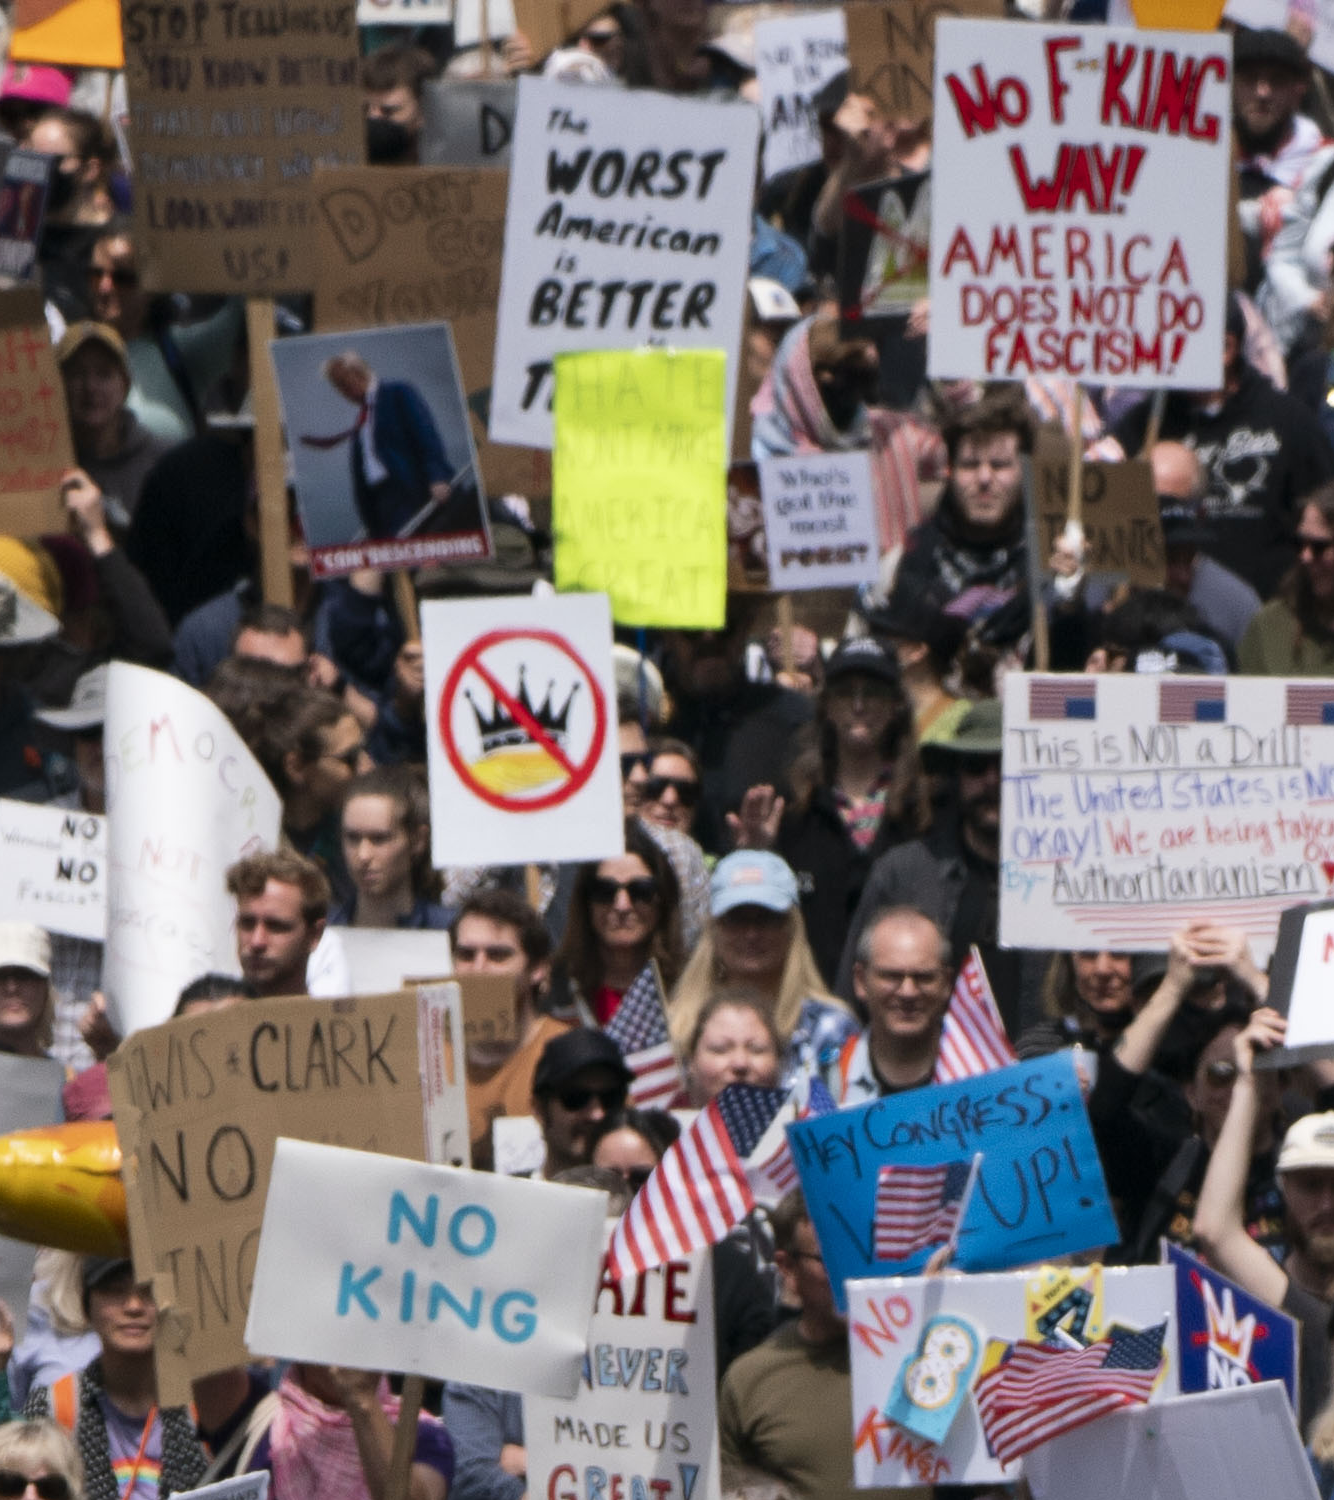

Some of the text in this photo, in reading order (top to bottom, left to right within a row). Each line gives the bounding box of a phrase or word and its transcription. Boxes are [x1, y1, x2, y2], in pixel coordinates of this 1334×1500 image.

[547, 109, 589, 135] The
[546, 148, 725, 199] WORST
[1010, 144, 1146, 214] WAY!
[535, 204, 722, 254] American
[942, 226, 1190, 287] AMERICA
[528, 279, 718, 330] BETTER
[959, 282, 1205, 335] DOES NOT DO
[985, 326, 1185, 378] FASCISM!
[1009, 723, 1312, 770] This is NOT a Drill:
[1009, 774, 1067, 822] The
[1072, 768, 1163, 819] United
[1169, 767, 1273, 815] States
[1276, 771, 1302, 802] is
[1107, 819, 1152, 856] We
[1156, 822, 1199, 852] are
[1204, 815, 1270, 860] being
[1052, 859, 1320, 902] Authoritarianism
[387, 1189, 497, 1259] NO
[336, 1261, 539, 1345] KING
[553, 1414, 692, 1454] MADE US
